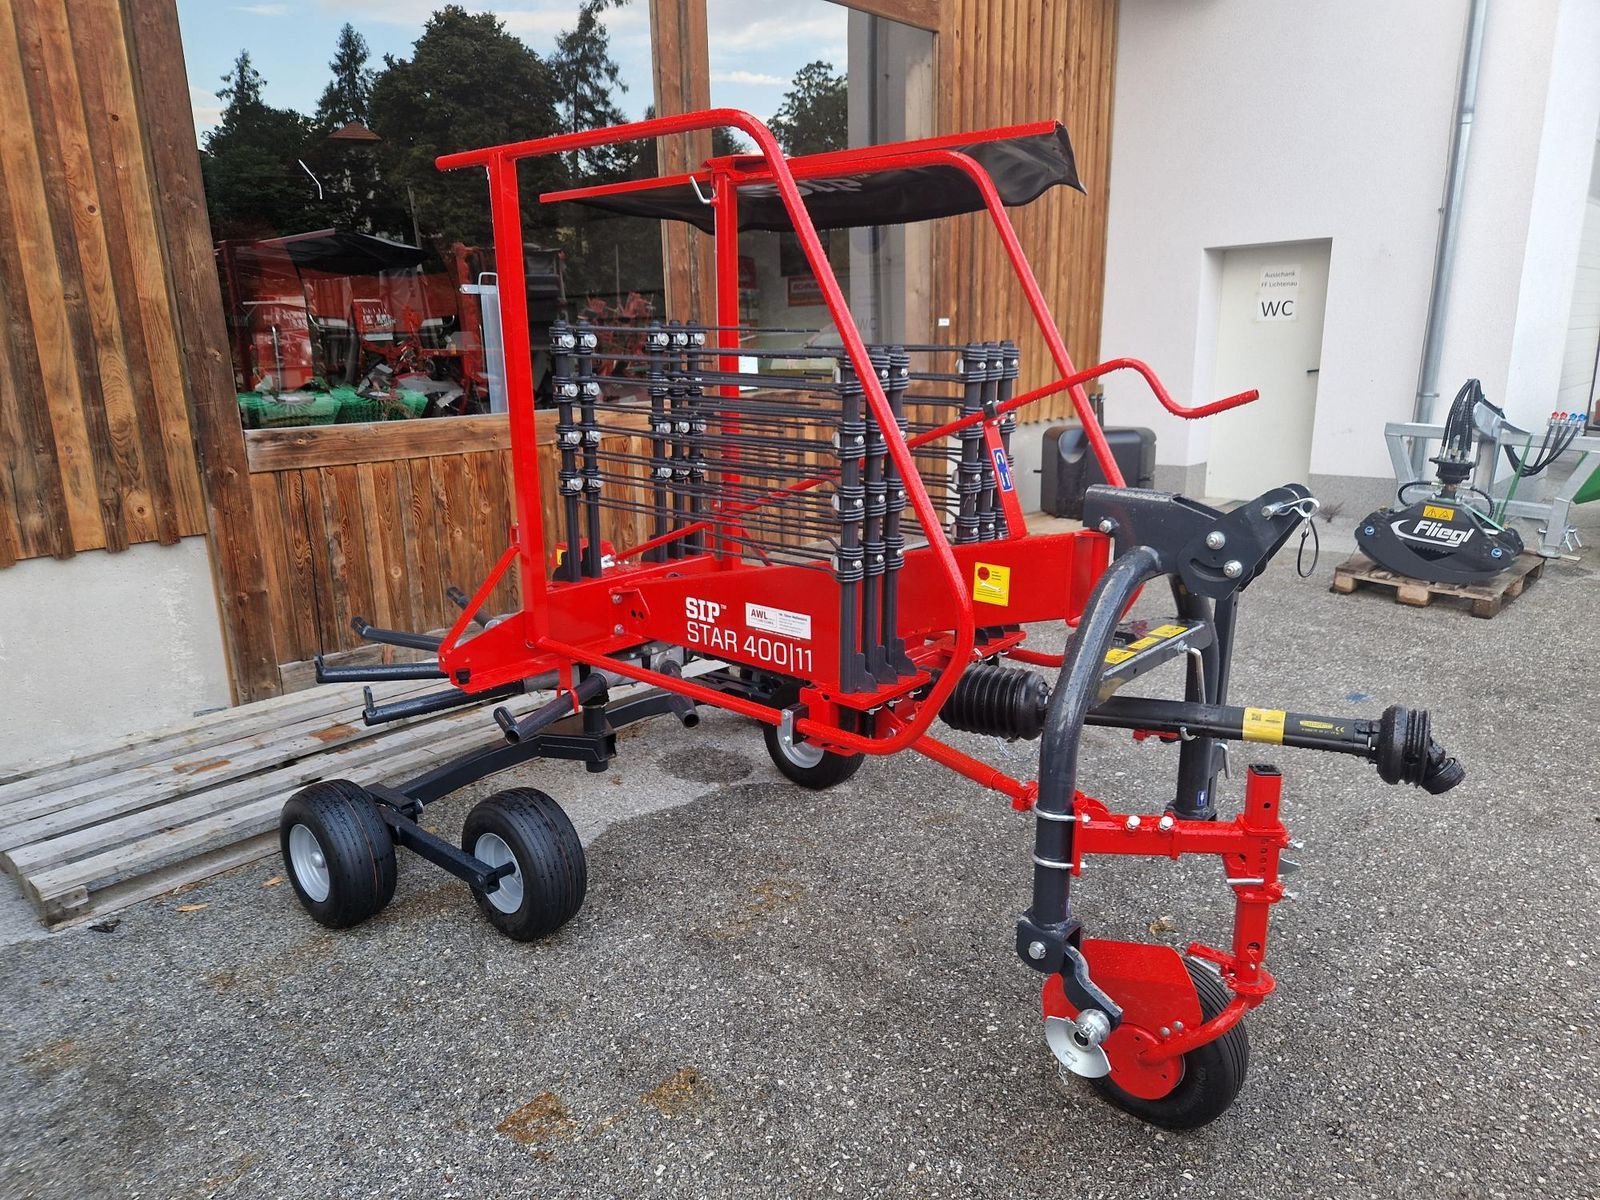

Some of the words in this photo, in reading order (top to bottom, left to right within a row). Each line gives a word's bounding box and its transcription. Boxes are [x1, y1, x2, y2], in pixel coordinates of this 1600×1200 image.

[1261, 300, 1294, 317] WC
[1413, 520, 1475, 545] Fliegl
[685, 596, 720, 623] SIP
[750, 608, 768, 620] AWL
[687, 621, 738, 653] STAR
